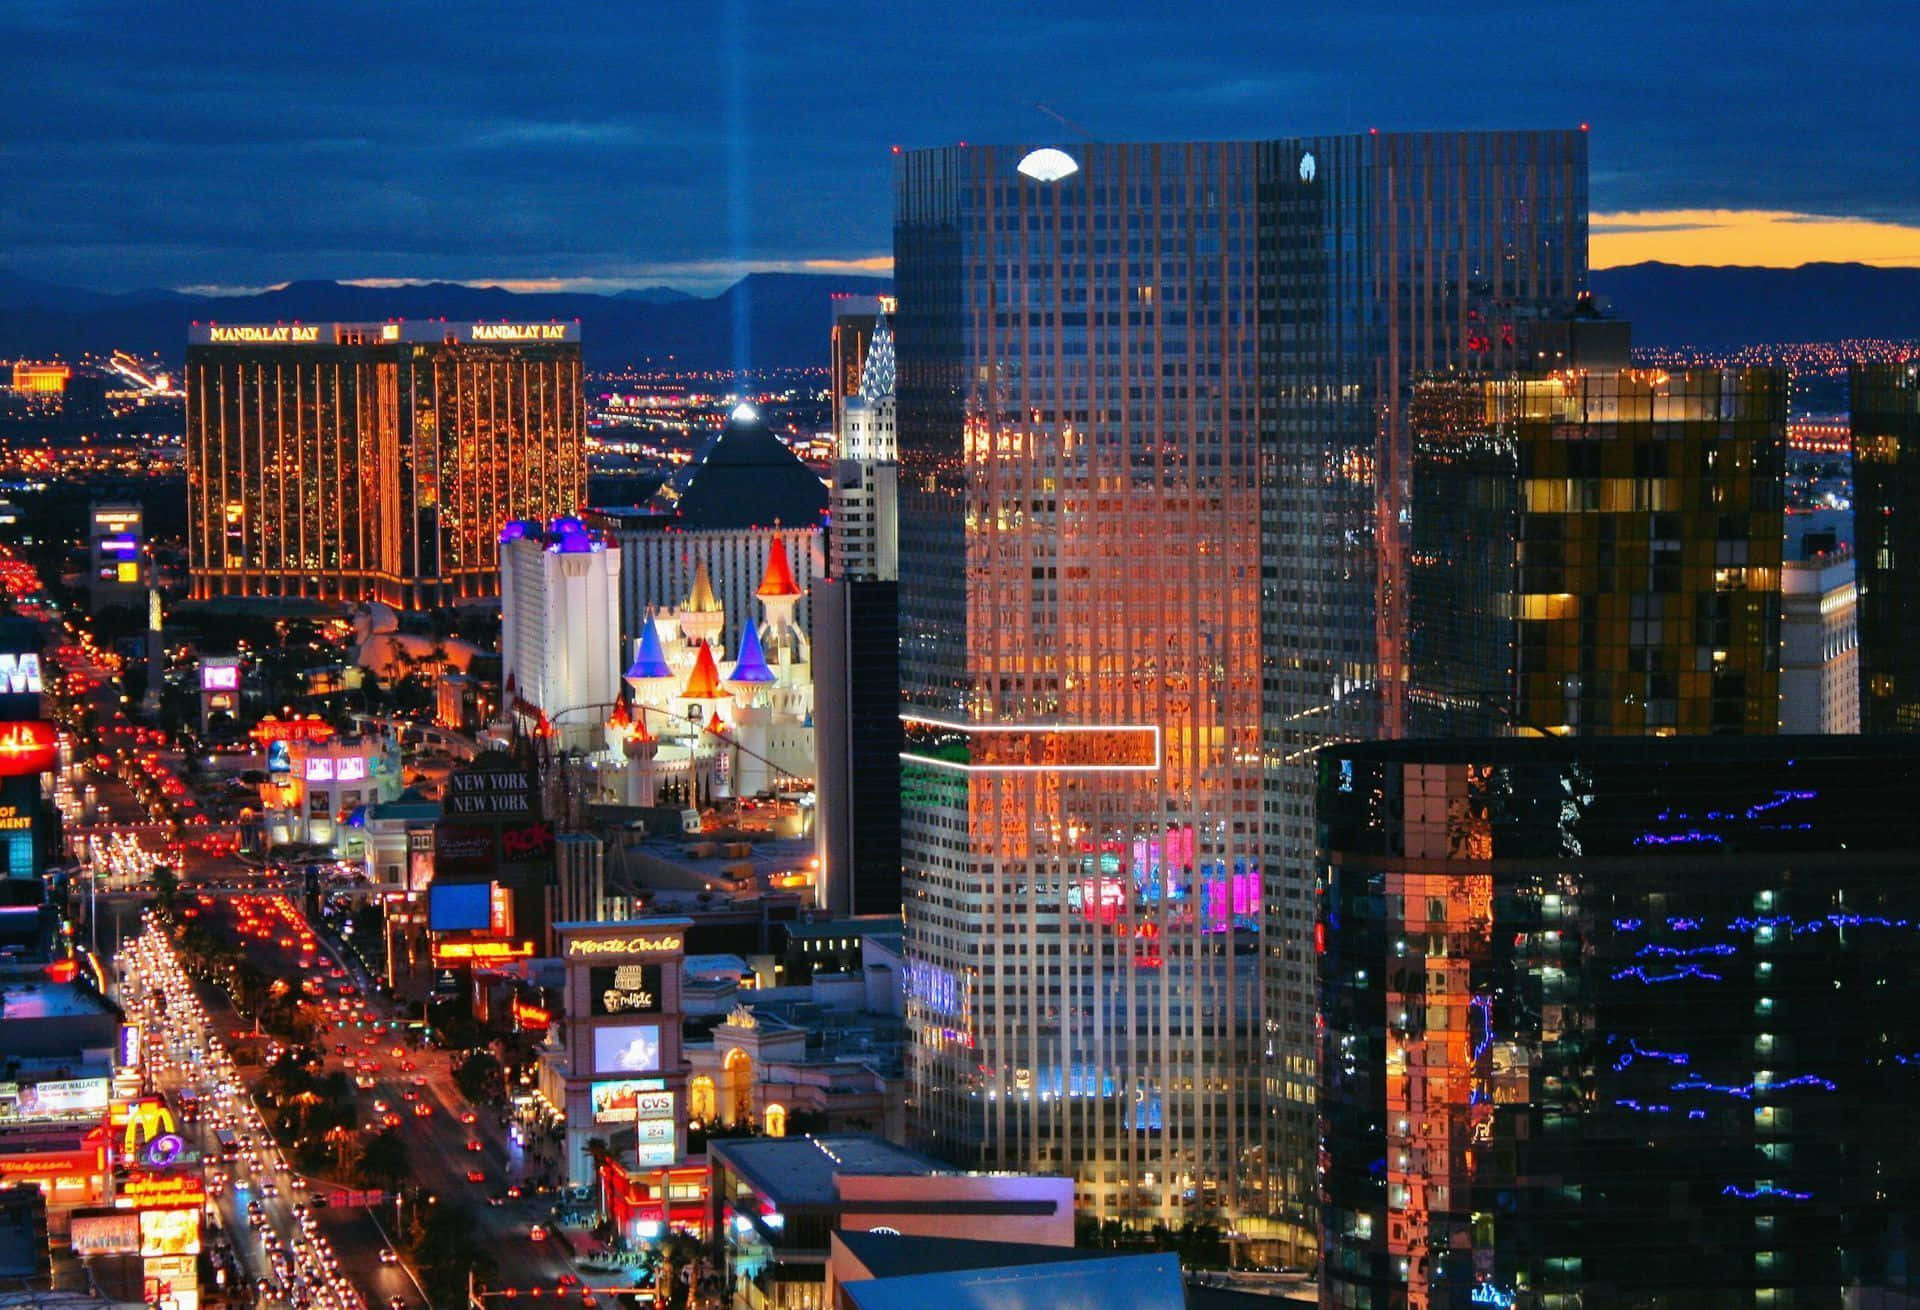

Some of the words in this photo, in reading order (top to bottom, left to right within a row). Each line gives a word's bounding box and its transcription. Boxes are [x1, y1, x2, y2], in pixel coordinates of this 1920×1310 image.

[210, 327, 289, 342] MANDALAY
[292, 326, 320, 341] BAY
[472, 325, 541, 340] MANDALAY
[542, 325, 566, 339] BAY
[453, 774, 485, 791] NEW
[489, 773, 528, 790] YORK
[453, 796, 485, 813] NEW
[489, 795, 528, 811] YORK
[569, 938, 626, 956] Monte
[626, 936, 681, 954] Carlo
[39, 1082, 68, 1092] GEORGE
[69, 1080, 98, 1089] WALLACE
[641, 1098, 670, 1109] CVS
